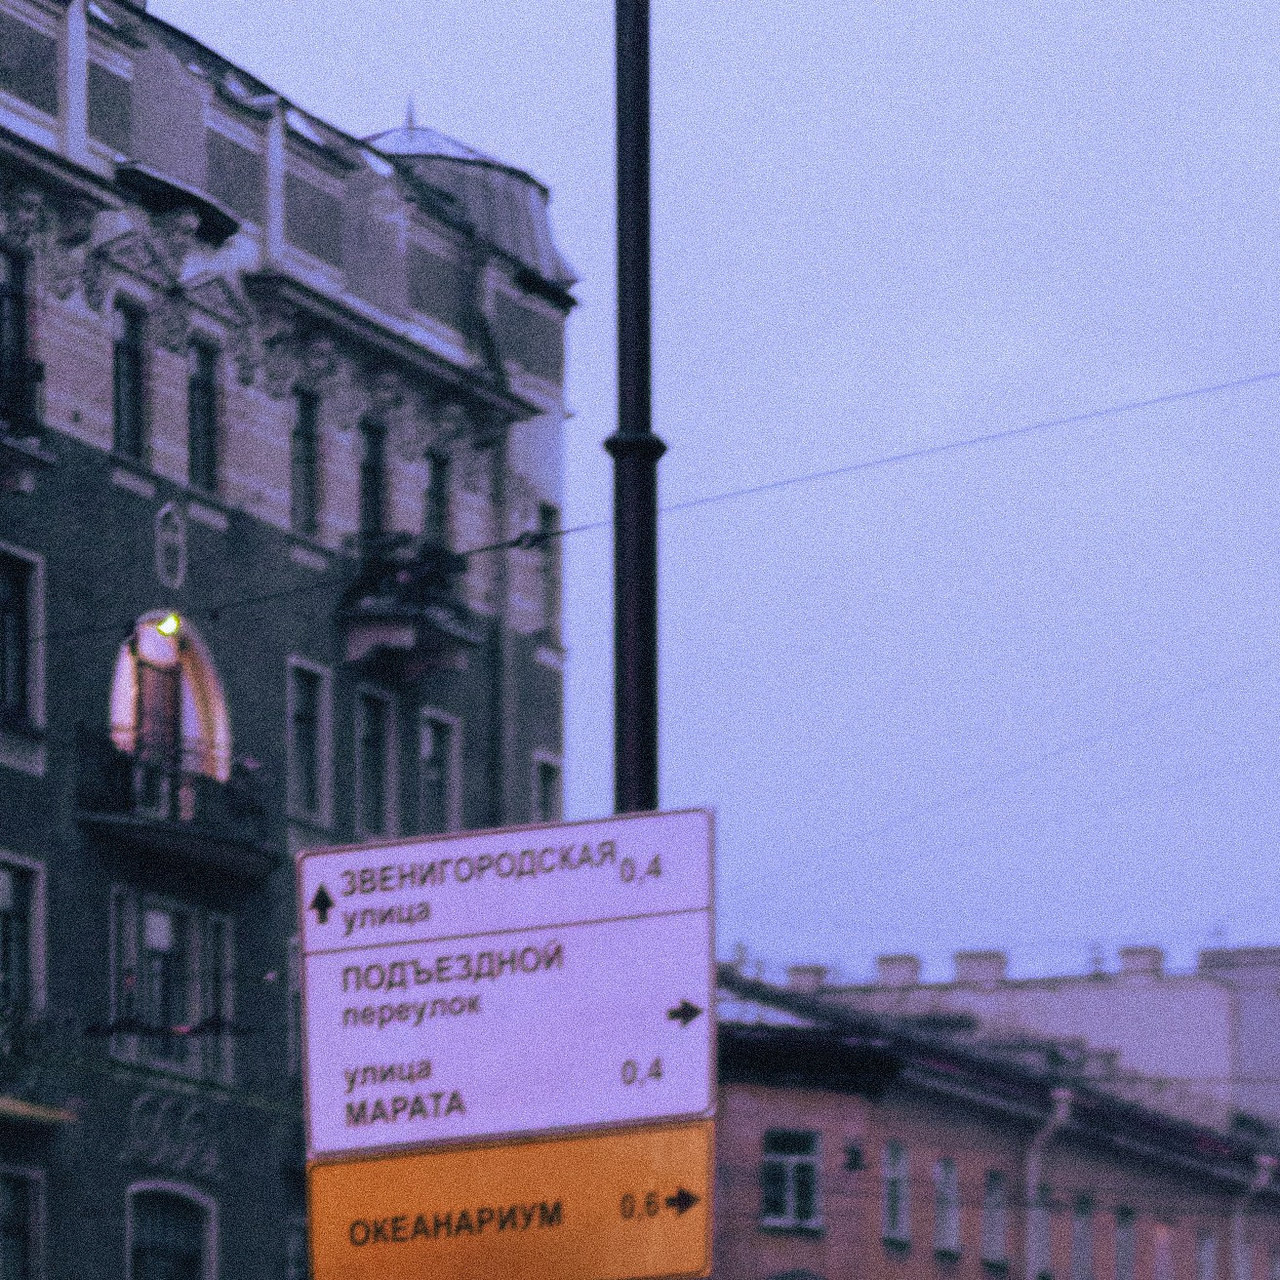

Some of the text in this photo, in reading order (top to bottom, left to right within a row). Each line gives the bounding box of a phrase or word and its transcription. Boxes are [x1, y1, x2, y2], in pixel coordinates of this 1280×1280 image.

[341, 841, 618, 897] ЗВЕНИГОРОДСКАЯ
[341, 898, 431, 936] улица
[342, 938, 564, 994] ПОДЪЕЗДНОЙ
[342, 992, 481, 1029] переулок
[344, 1058, 432, 1095] улица
[346, 1090, 466, 1128] МАРАТА
[349, 1200, 564, 1248] ОКЕАНАРИУМ
